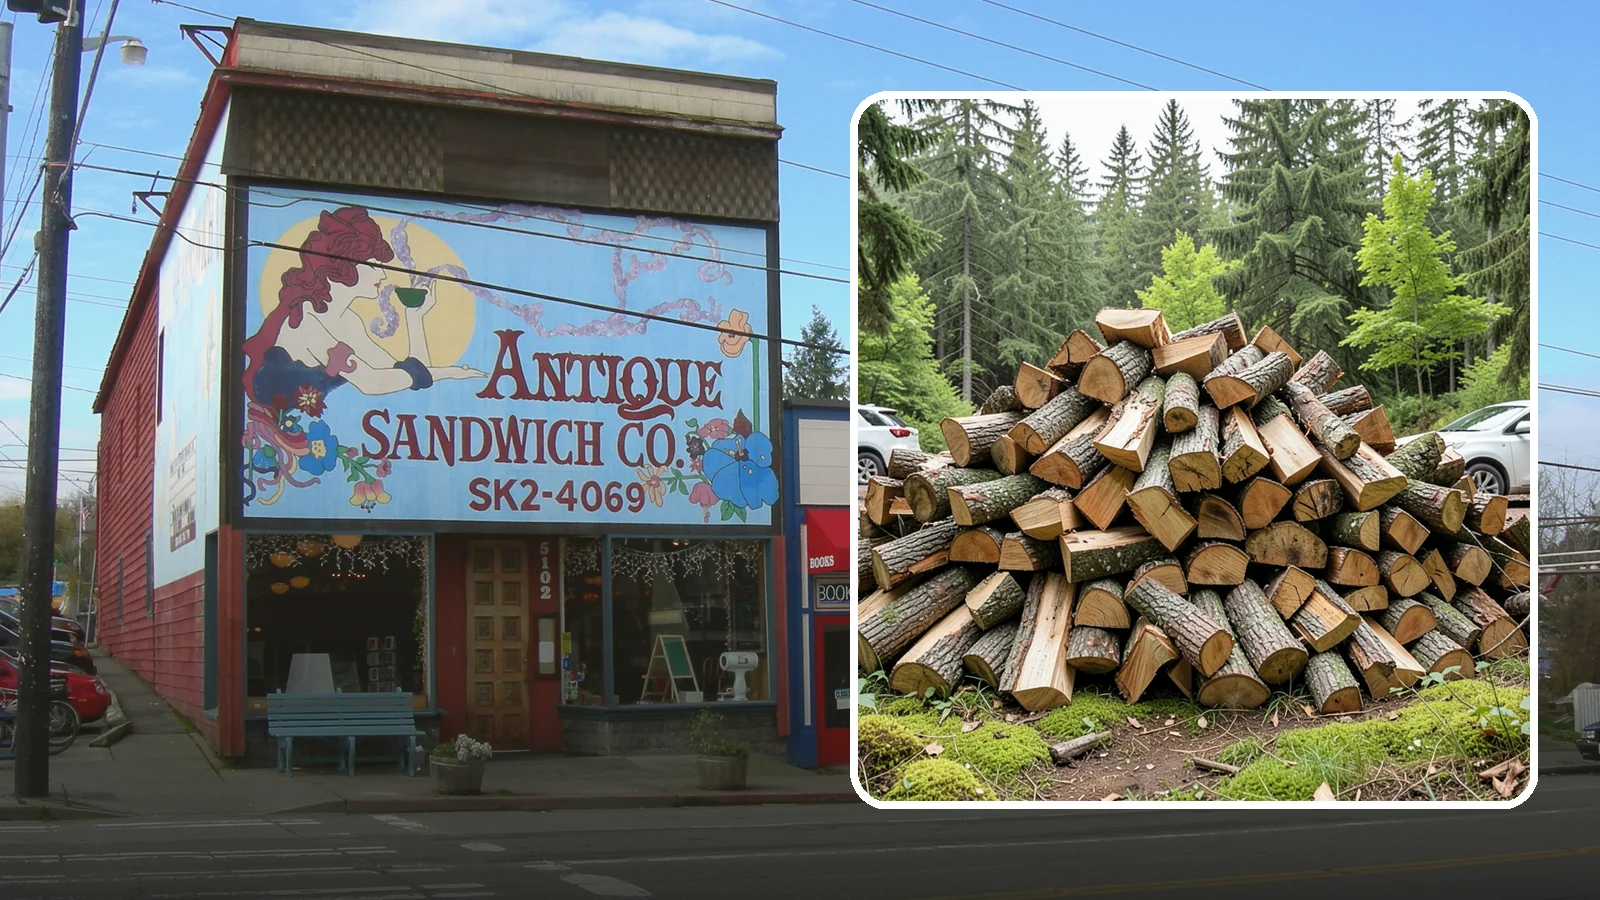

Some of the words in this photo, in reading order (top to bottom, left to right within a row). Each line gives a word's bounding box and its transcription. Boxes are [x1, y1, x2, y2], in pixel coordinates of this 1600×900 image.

[475, 328, 724, 421] ANTIQUE
[361, 408, 605, 468] SANDWICH
[617, 422, 685, 469] CO.
[468, 477, 646, 513] SK2-4069
[539, 541, 552, 600] 5102
[809, 555, 835, 569] BOOKS
